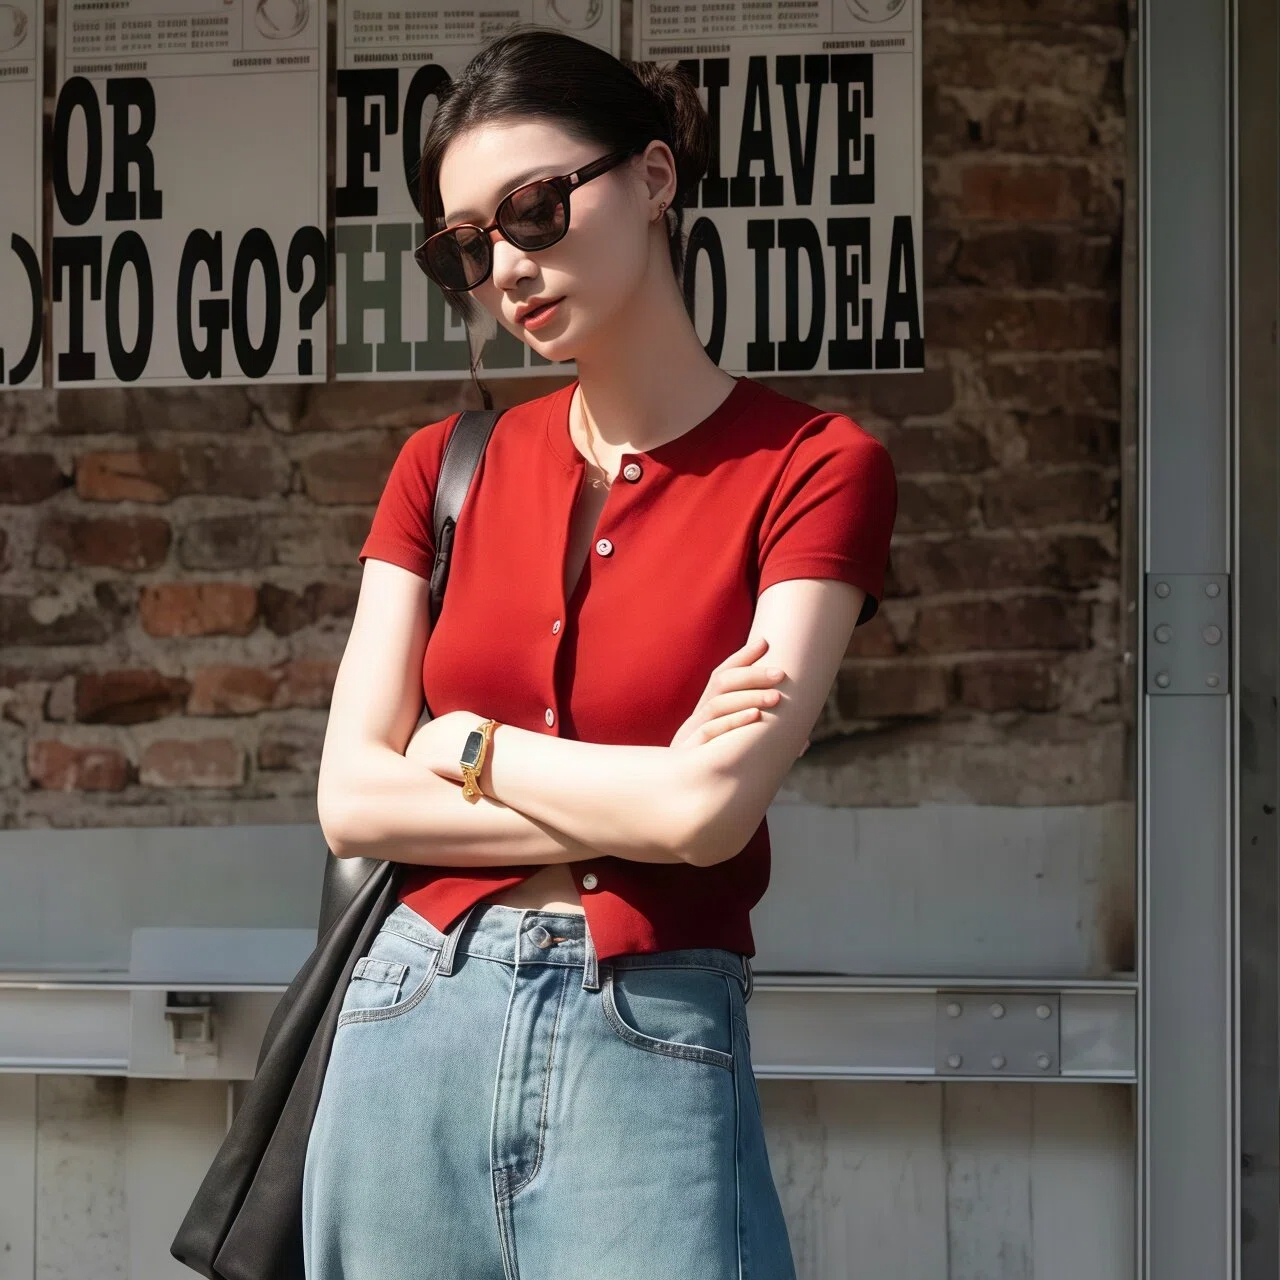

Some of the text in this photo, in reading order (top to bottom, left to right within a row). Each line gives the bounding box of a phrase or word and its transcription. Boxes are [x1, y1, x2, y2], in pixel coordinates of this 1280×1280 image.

[53, 76, 163, 226] OR
[53, 225, 327, 382] TO GO?
[747, 215, 925, 372] IDEA
